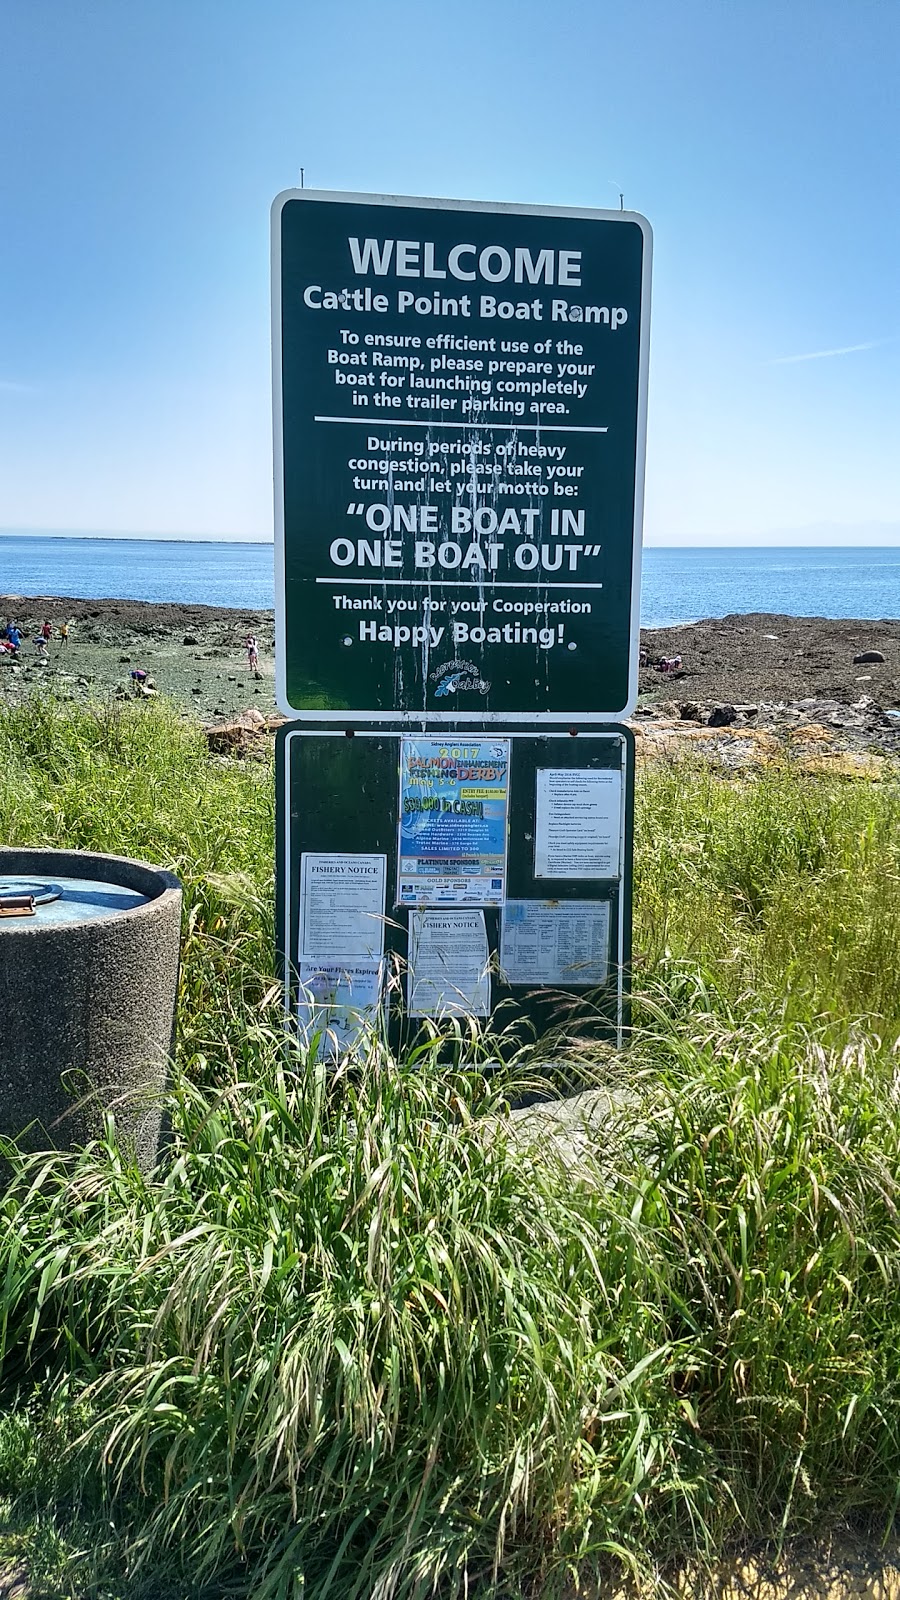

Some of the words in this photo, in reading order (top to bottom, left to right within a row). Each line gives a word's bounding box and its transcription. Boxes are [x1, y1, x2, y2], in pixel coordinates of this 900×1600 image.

[348, 236, 583, 287] WELCOME
[303, 285, 390, 313] Cattle
[397, 291, 471, 317] Point
[480, 295, 543, 321] Boat
[551, 299, 629, 330] Ramp
[340, 329, 360, 345] To
[364, 334, 422, 349] ensure
[426, 334, 497, 352] efficient
[500, 340, 529, 354] use
[533, 339, 552, 355] of
[555, 340, 584, 356] the
[327, 350, 368, 366] Boat
[371, 352, 426, 372] Ramp,
[430, 354, 484, 374] please
[488, 359, 553, 377] prepare
[557, 362, 596, 378] your
[335, 370, 376, 387] boat
[379, 371, 406, 388] for
[409, 373, 493, 395] launching
[496, 378, 588, 398] completely
[352, 391, 370, 407] in
[373, 391, 402, 408] the
[406, 393, 458, 411] trailer
[461, 395, 526, 416] parking
[529, 401, 571, 415] area.
[367, 437, 425, 457] During
[429, 439, 491, 458] periods
[495, 440, 515, 457] of
[517, 443, 567, 461] heavy
[348, 457, 446, 478] congestion,
[450, 460, 503, 479] please
[506, 461, 542, 478] take
[546, 465, 585, 479] your
[352, 477, 389, 491] turn
[393, 478, 425, 493] and
[429, 478, 452, 493] let
[456, 481, 494, 497] your
[498, 481, 550, 496] motto
[553, 482, 579, 497] be:
[346, 502, 439, 534] “ONE
[451, 507, 540, 536] BOAT
[550, 509, 586, 537] IN
[329, 538, 403, 567] ONE
[414, 541, 504, 570] BOAT
[514, 543, 601, 571] OUT”
[333, 595, 383, 611] Thank
[386, 599, 418, 614] you
[422, 596, 447, 612] for
[451, 599, 489, 615] your
[492, 599, 592, 616] Cooperation
[358, 620, 445, 648] Happy
[453, 622, 565, 649] Boating!
[408, 757, 457, 769] SALMON
[457, 760, 507, 769] ENHANCEMENT
[439, 748, 480, 759] 2017
[409, 778, 434, 787] May
[410, 769, 458, 779] FISHING
[457, 768, 507, 782] DERBY
